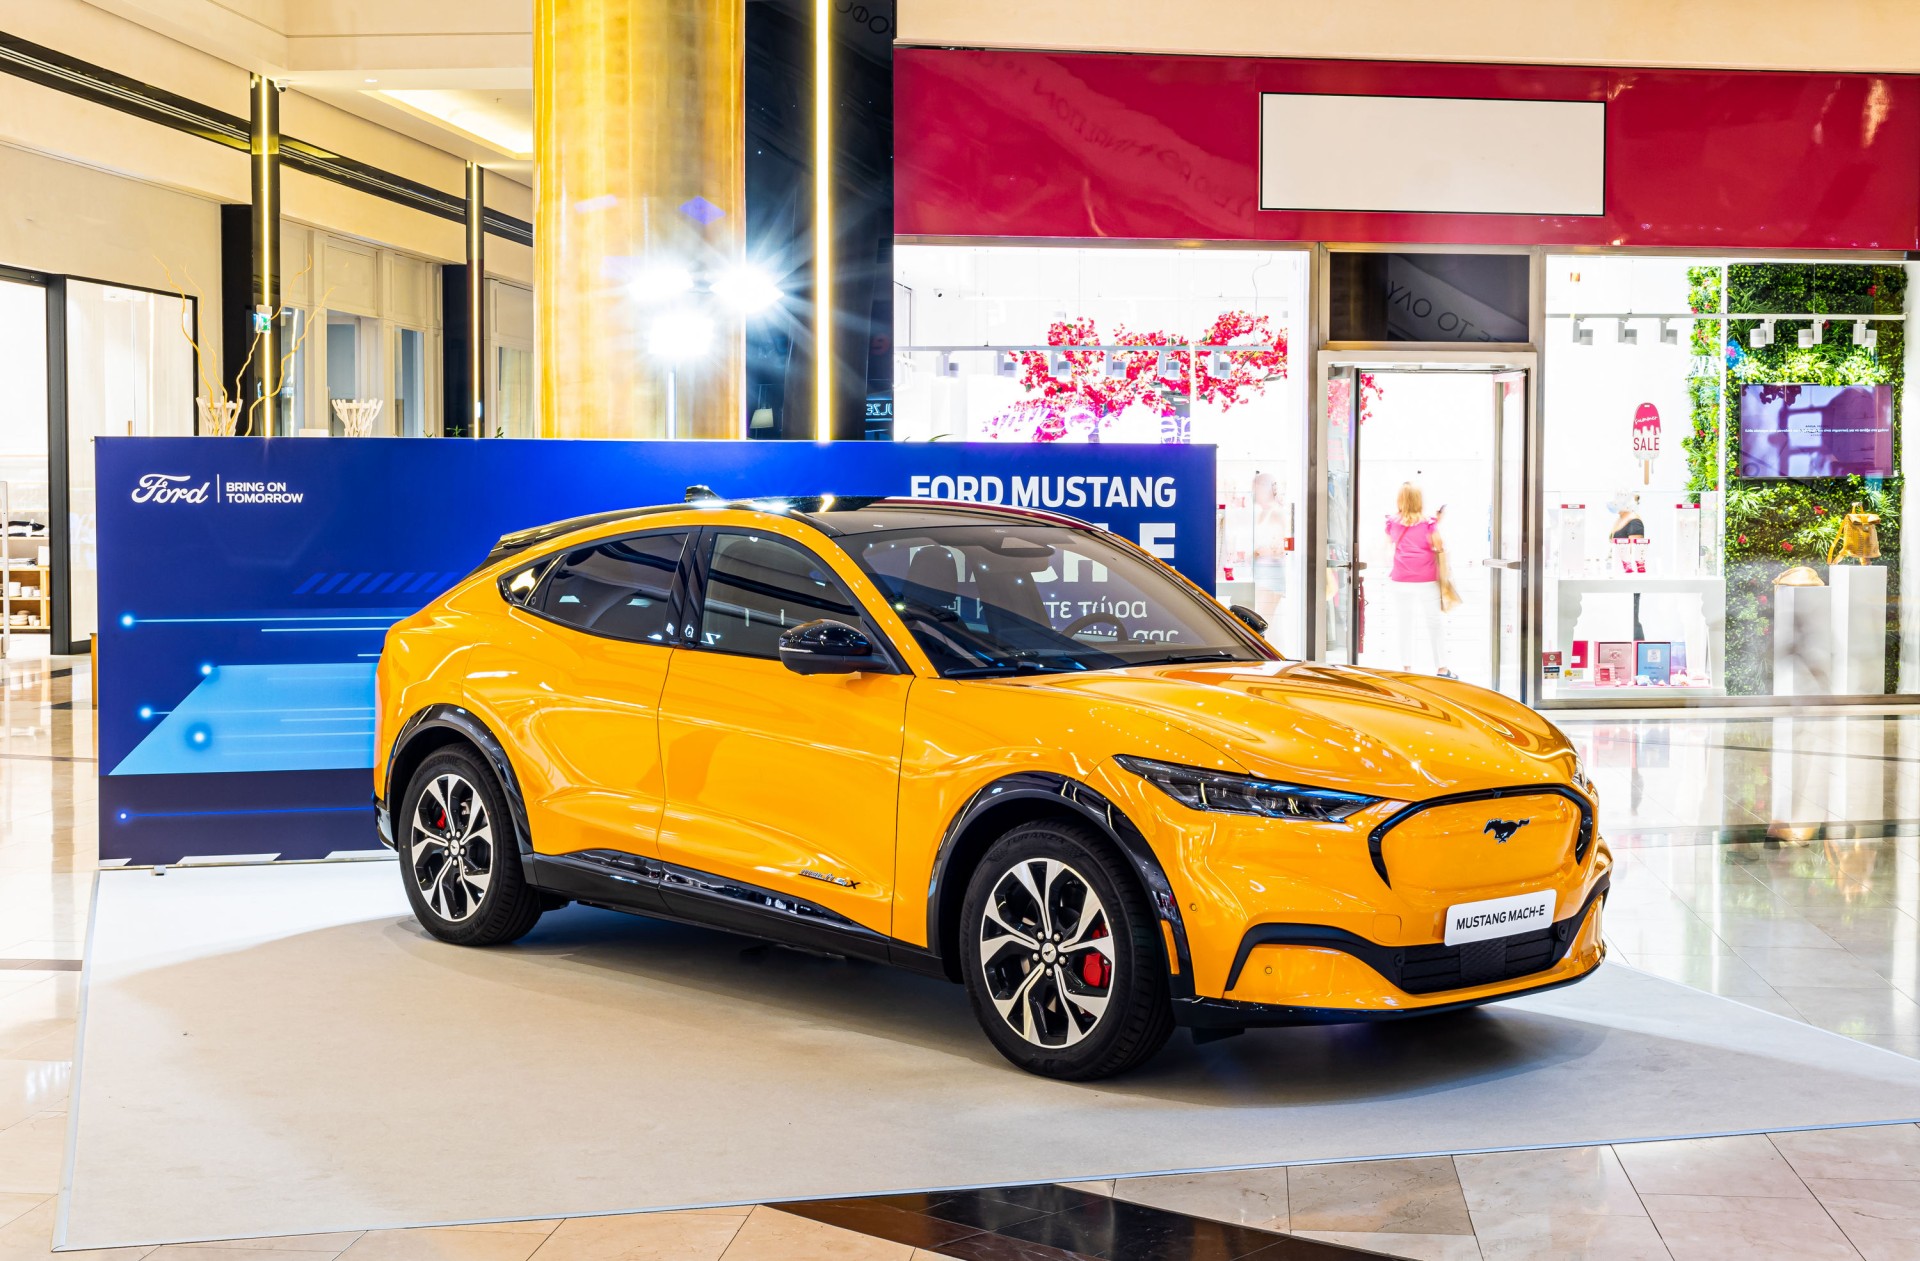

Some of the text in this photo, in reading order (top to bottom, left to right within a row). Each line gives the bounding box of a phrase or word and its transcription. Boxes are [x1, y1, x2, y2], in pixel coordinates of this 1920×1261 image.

[1633, 437, 1660, 451] SALE
[131, 473, 210, 504] Ford
[226, 482, 287, 493] BRING ON
[911, 476, 1177, 508] FORD MUSTANG
[226, 493, 303, 504] TOMORROW
[1456, 904, 1546, 931] MUSTANG MACH-E
